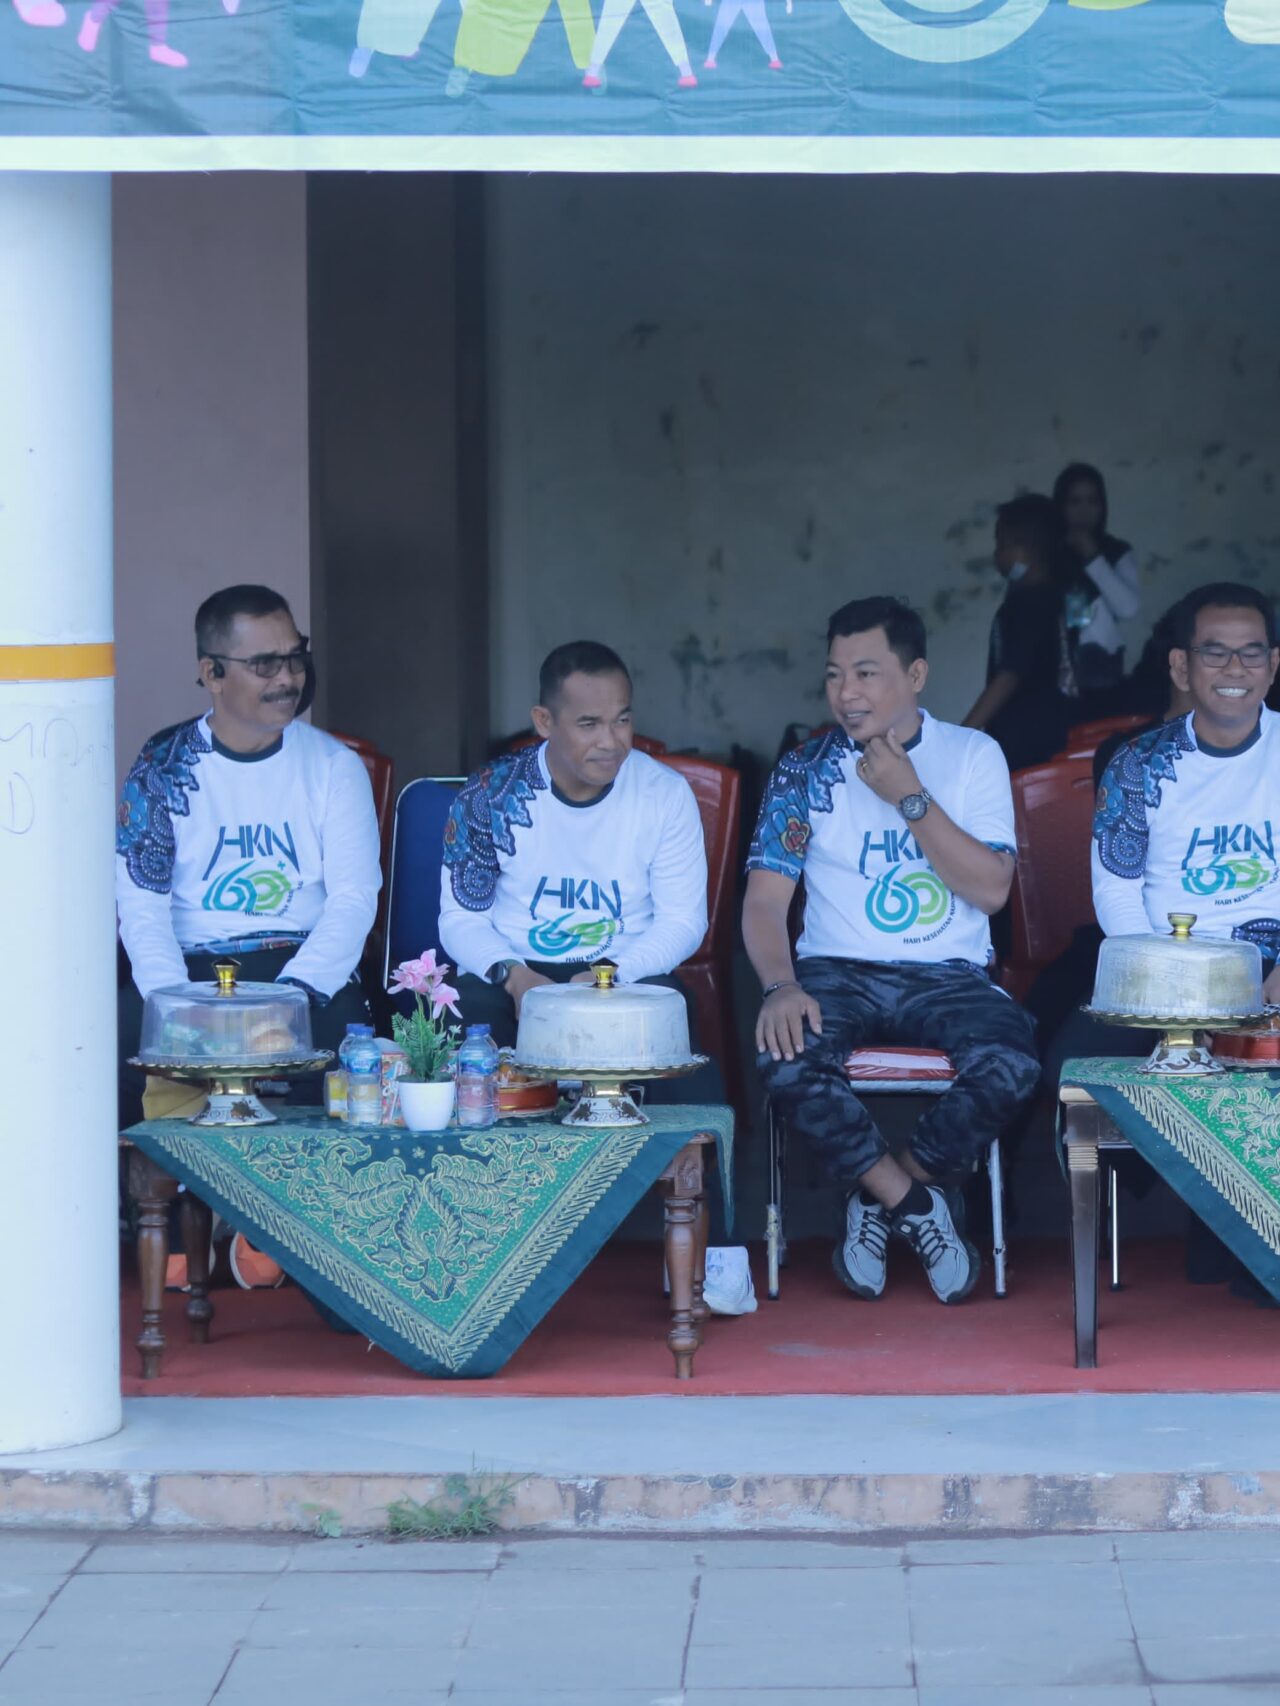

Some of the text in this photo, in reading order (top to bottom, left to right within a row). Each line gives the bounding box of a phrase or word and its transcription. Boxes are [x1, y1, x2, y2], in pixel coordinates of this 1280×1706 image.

[202, 821, 300, 881] HKN
[1181, 820, 1276, 870] HKN
[529, 876, 622, 921] HKN
[865, 863, 949, 934] 60
